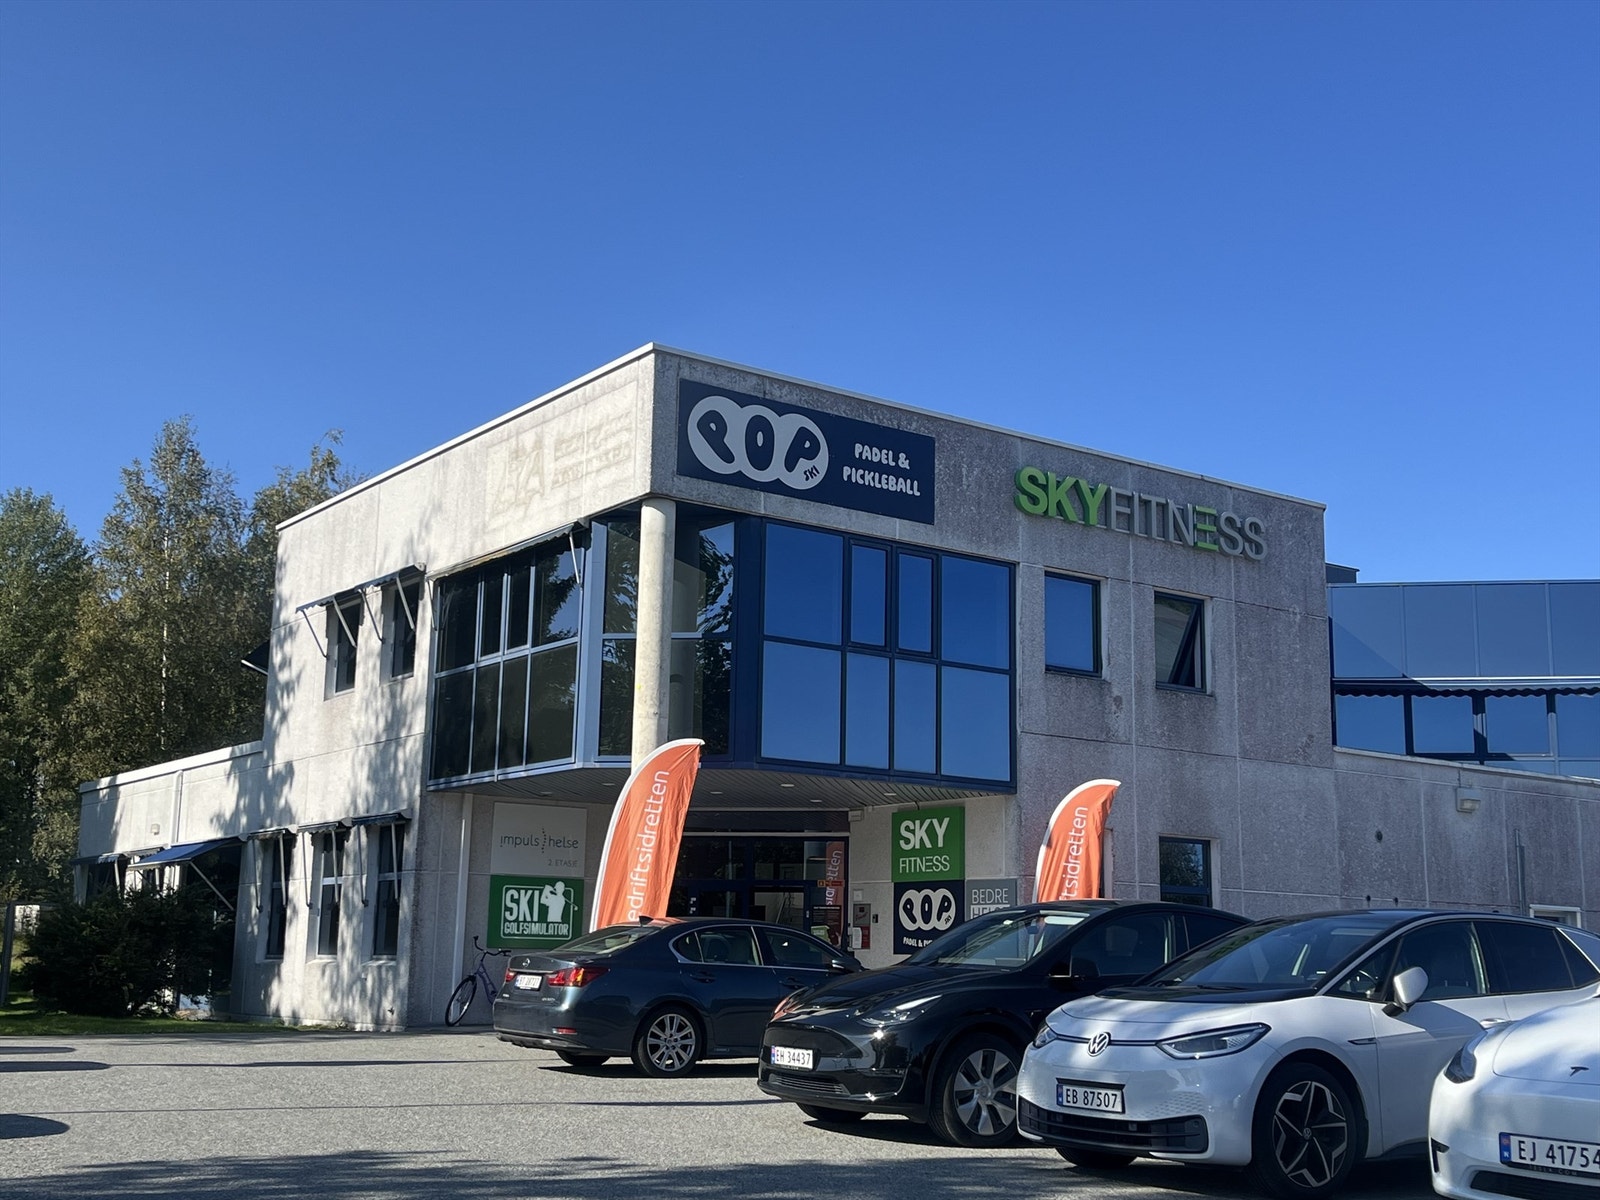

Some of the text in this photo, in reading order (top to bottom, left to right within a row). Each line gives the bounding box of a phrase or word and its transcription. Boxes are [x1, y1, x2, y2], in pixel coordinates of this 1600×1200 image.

[696, 409, 821, 473] POP
[854, 443, 910, 470] PADEL &
[803, 464, 820, 482] SKI
[842, 466, 921, 496] PICKLEBALL
[500, 834, 579, 849] impuls helse
[899, 817, 950, 850] SKY
[899, 855, 950, 873] FITNESS
[504, 889, 540, 921] SKI
[971, 888, 1009, 904] BEDRE
[902, 894, 952, 925] POP
[504, 922, 569, 936] GOLFSIMULATOR
[776, 1049, 811, 1065] EH 34437
[1065, 1088, 1118, 1108] EB 87507
[1518, 1140, 1600, 1169] EJ 41754
